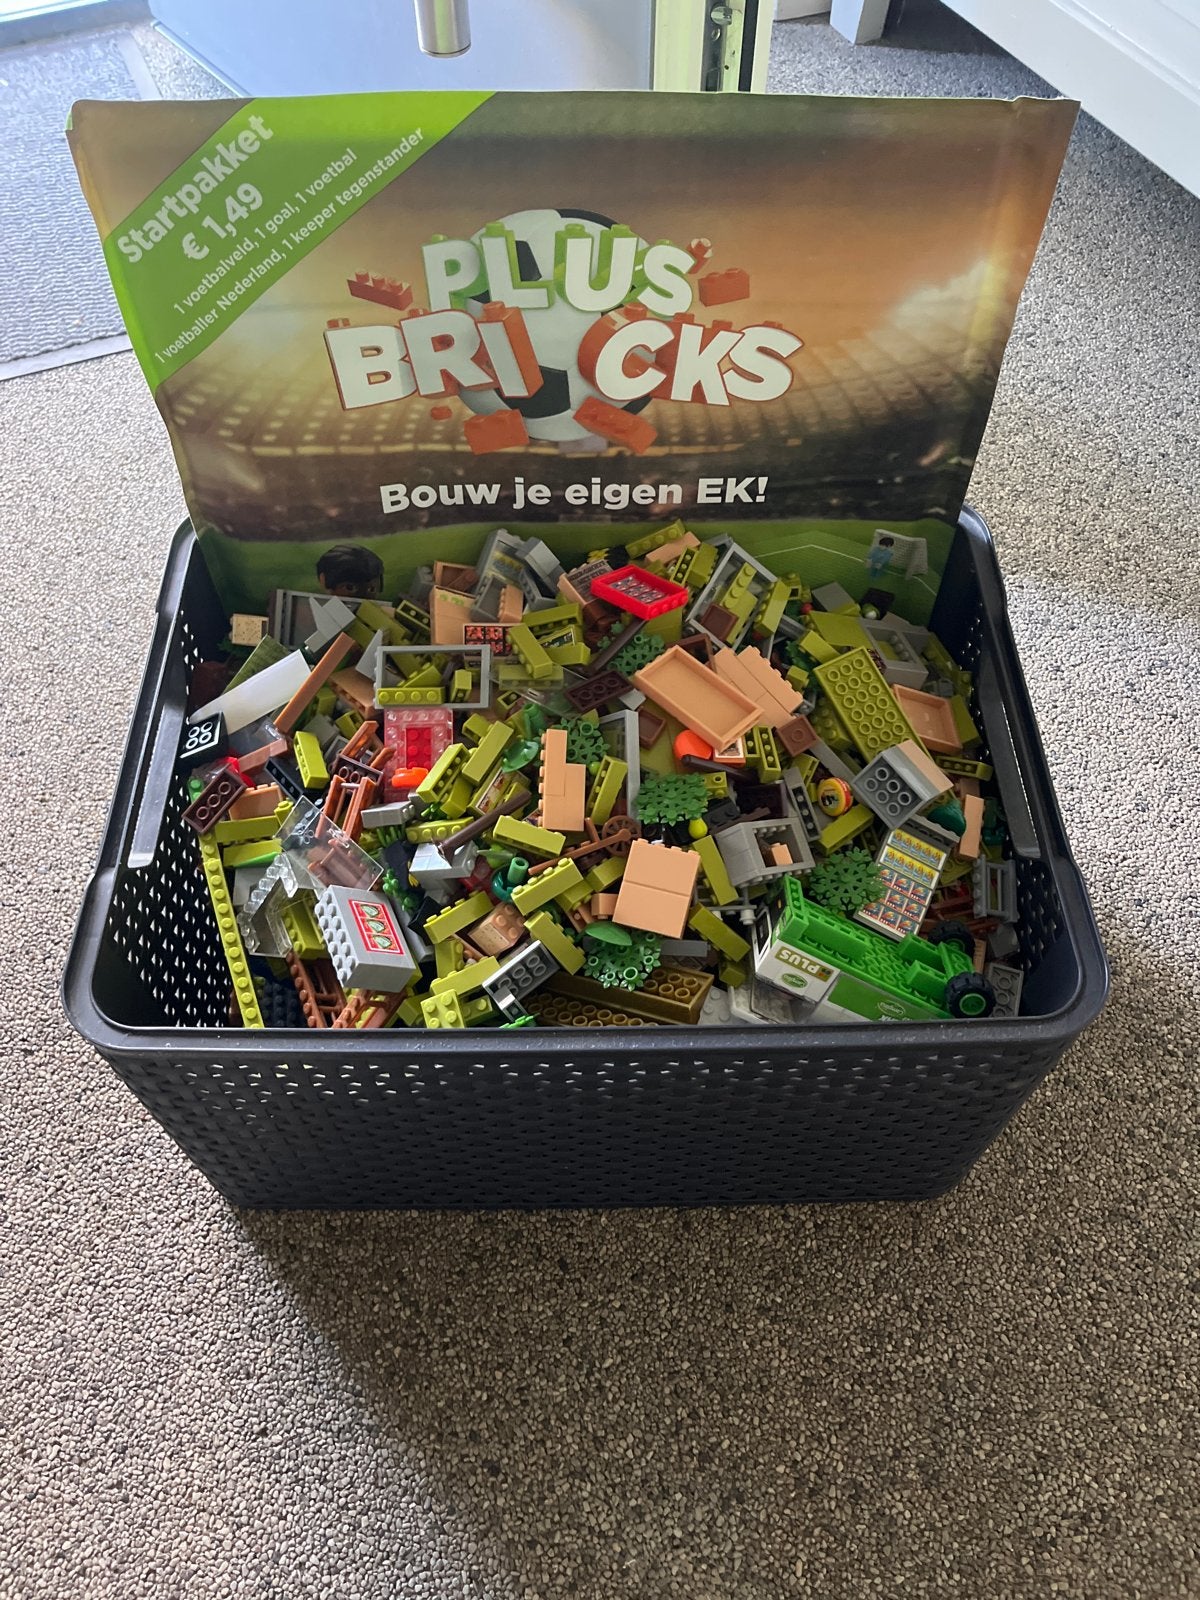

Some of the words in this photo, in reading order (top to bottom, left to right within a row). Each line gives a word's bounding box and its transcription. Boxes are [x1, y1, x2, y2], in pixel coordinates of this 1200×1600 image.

[117, 114, 274, 263] Startpakket
[173, 303, 185, 315] 1
[183, 237, 260, 308] voetbalveld,
[254, 228, 266, 239] 1
[265, 202, 300, 234] goal,
[295, 192, 307, 204] 1
[305, 147, 358, 197] voetbal
[181, 232, 210, 260] €
[202, 182, 263, 239] 1,49
[154, 352, 165, 364] 1
[162, 308, 219, 358] voetballer
[216, 248, 287, 311] Nederland,
[281, 239, 293, 251] 1
[289, 202, 337, 245] keeper
[335, 127, 424, 206] tegenstander
[421, 224, 698, 317] PLUS
[323, 305, 805, 411] BRICKS
[380, 482, 501, 514] Bouw
[512, 477, 556, 510] je
[564, 478, 683, 507] eigen
[697, 476, 770, 504] EK!
[779, 949, 821, 974] PLUS
